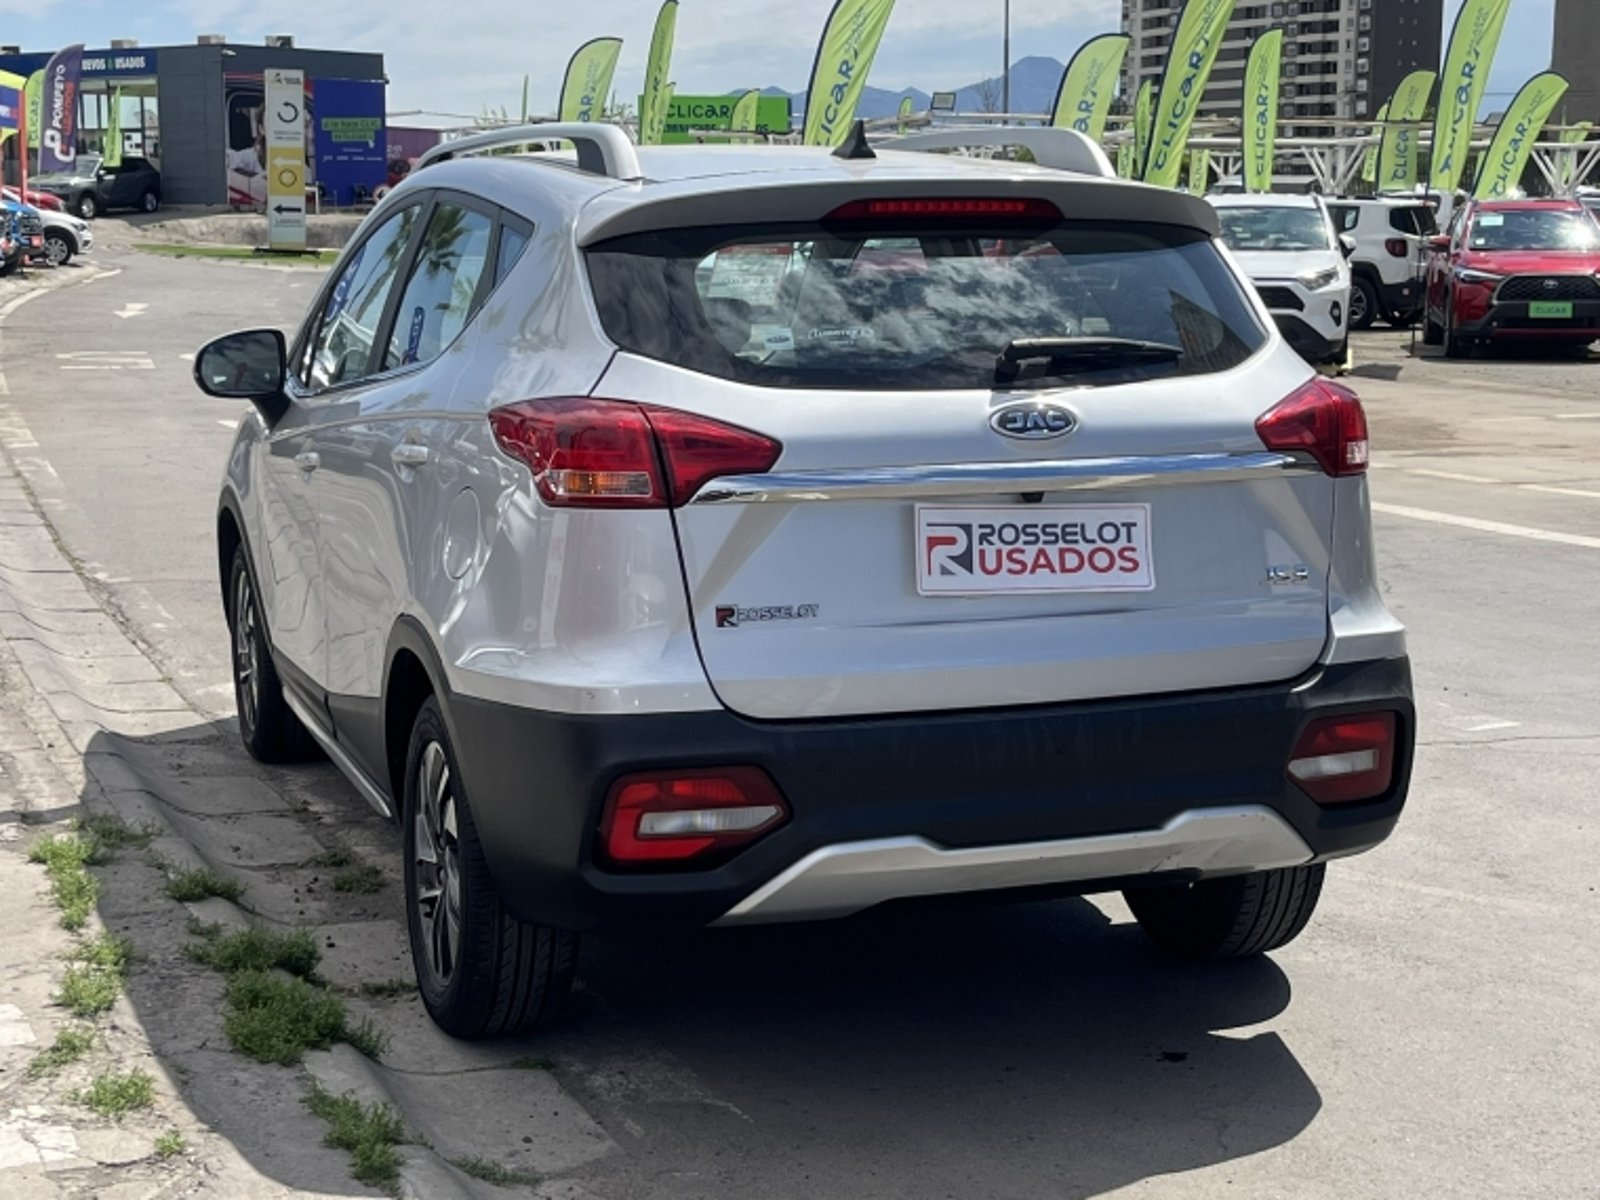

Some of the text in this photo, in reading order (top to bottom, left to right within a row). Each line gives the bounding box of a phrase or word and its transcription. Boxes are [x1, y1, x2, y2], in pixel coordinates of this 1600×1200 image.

[82, 58, 105, 70] UEVOS
[52, 64, 66, 128] POMPEYO
[1006, 410, 1066, 428] JAC
[978, 522, 1137, 545] ROSSELOT
[978, 547, 1140, 575] USADOS
